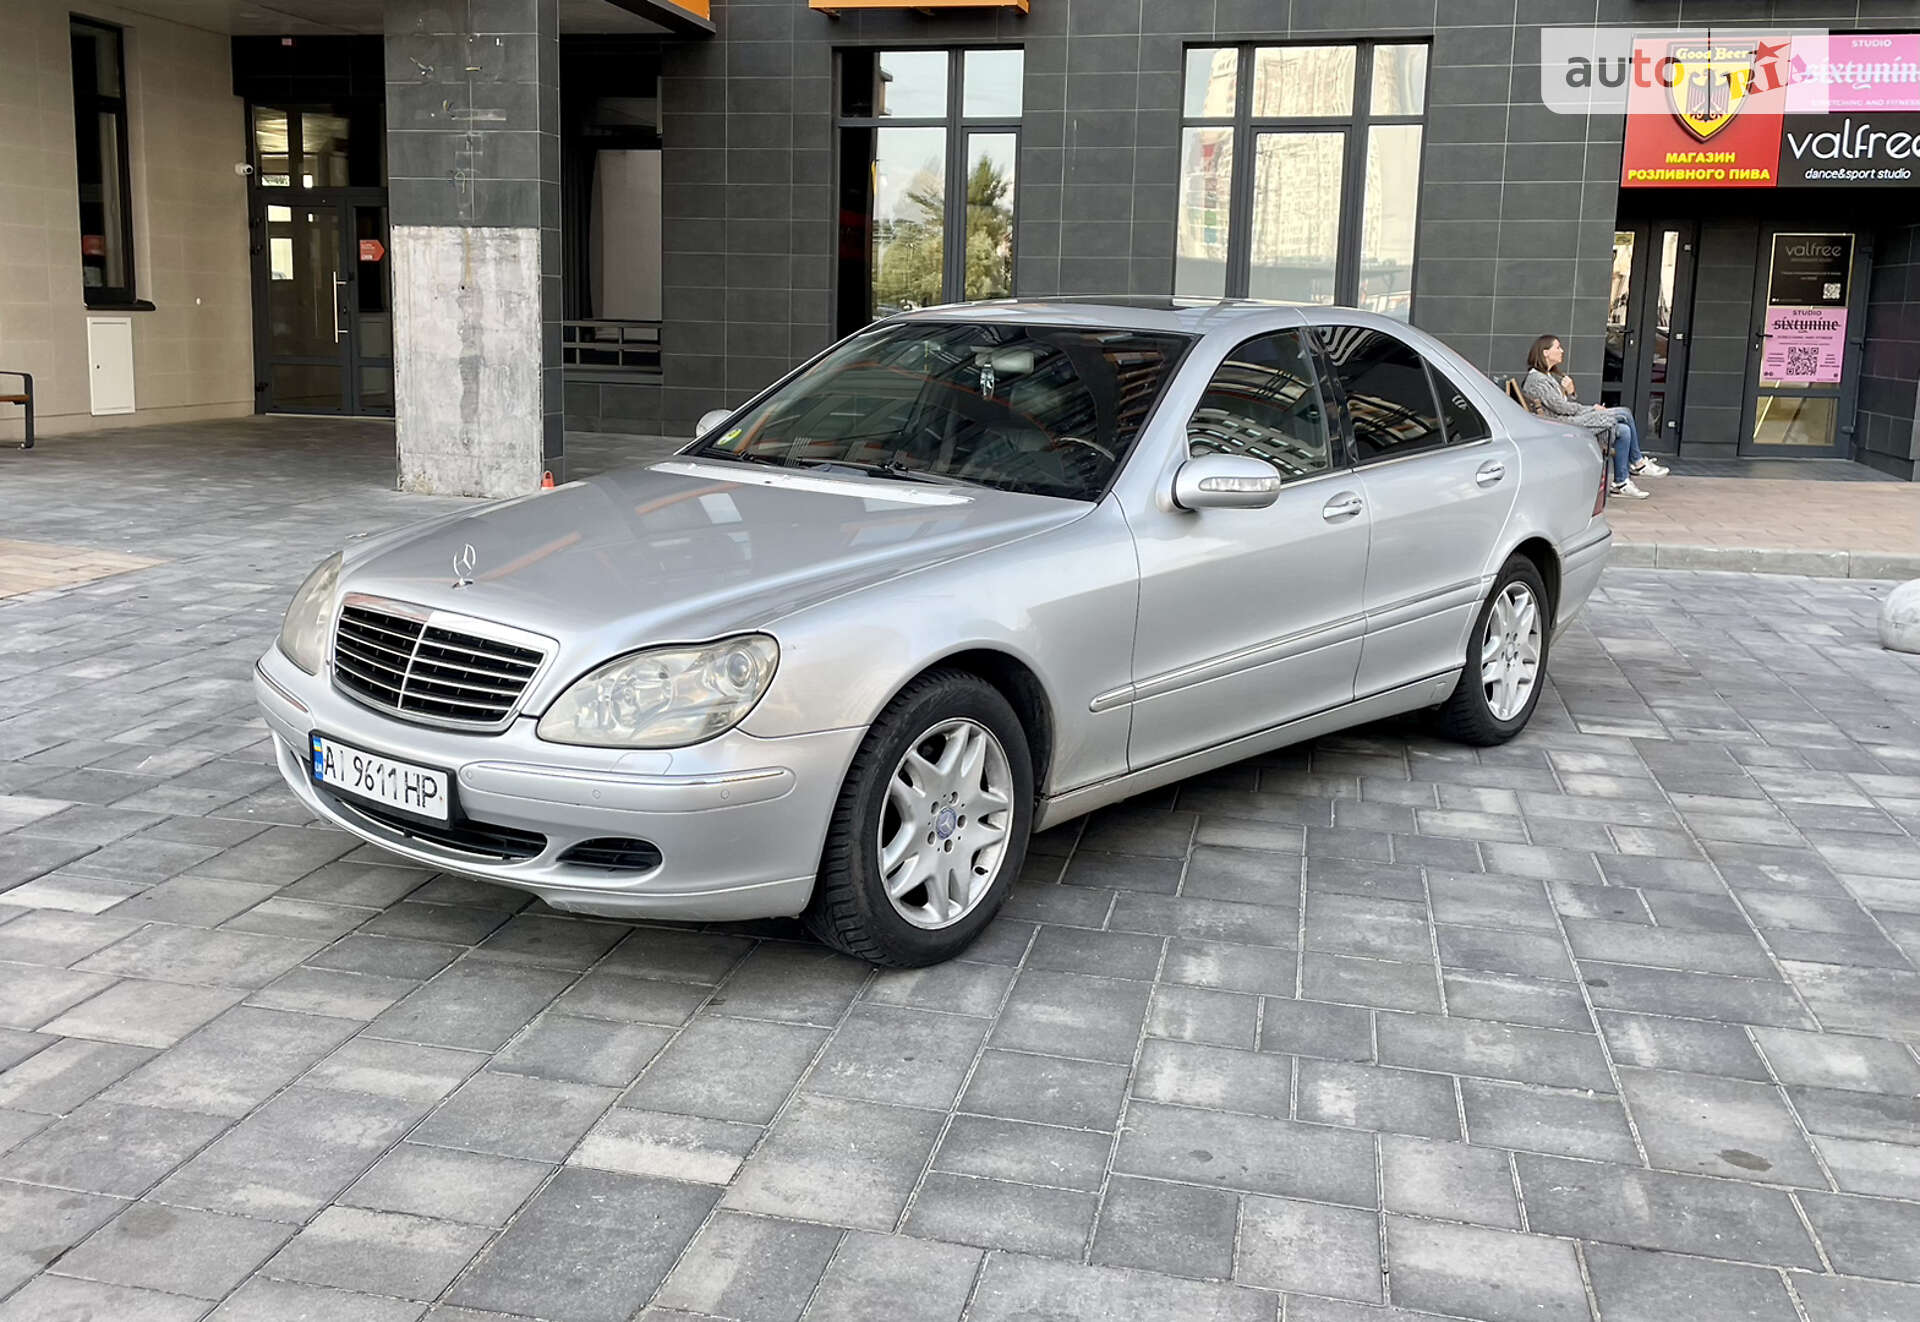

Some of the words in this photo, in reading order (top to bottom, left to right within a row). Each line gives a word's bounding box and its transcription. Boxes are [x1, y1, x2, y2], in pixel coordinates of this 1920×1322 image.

[1852, 39, 1892, 47] STUDIO
[1676, 47, 1711, 60] Good
[1715, 47, 1749, 60] Beer
[1665, 152, 1736, 164] МАГАЗИН
[1628, 169, 1725, 181] РОЗЛИВНОГО
[1729, 169, 1771, 180] ПИВА
[1805, 168, 1876, 181] dance&sport
[1877, 168, 1911, 179] studio
[1785, 241, 1842, 257] valfree
[1772, 316, 1841, 333] sixtynine
[324, 745, 345, 782] AI
[353, 755, 398, 801] 9611
[404, 770, 438, 808] HP
